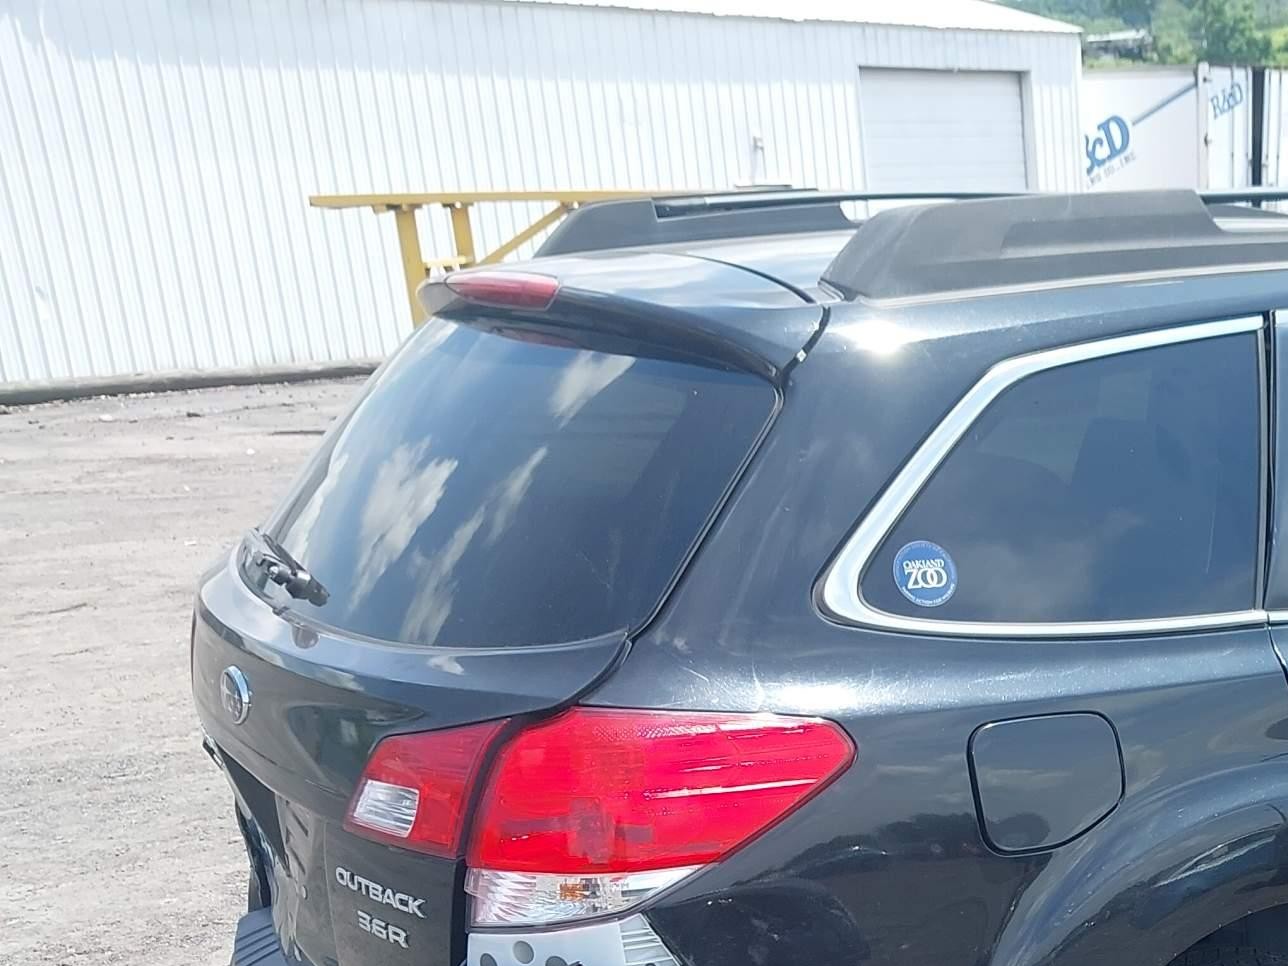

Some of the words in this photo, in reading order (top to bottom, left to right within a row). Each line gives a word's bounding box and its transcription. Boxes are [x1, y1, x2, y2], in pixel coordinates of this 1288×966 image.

[903, 558, 945, 570] OAKLAND
[904, 567, 948, 590] ZOO
[335, 866, 427, 919] OUTBACK
